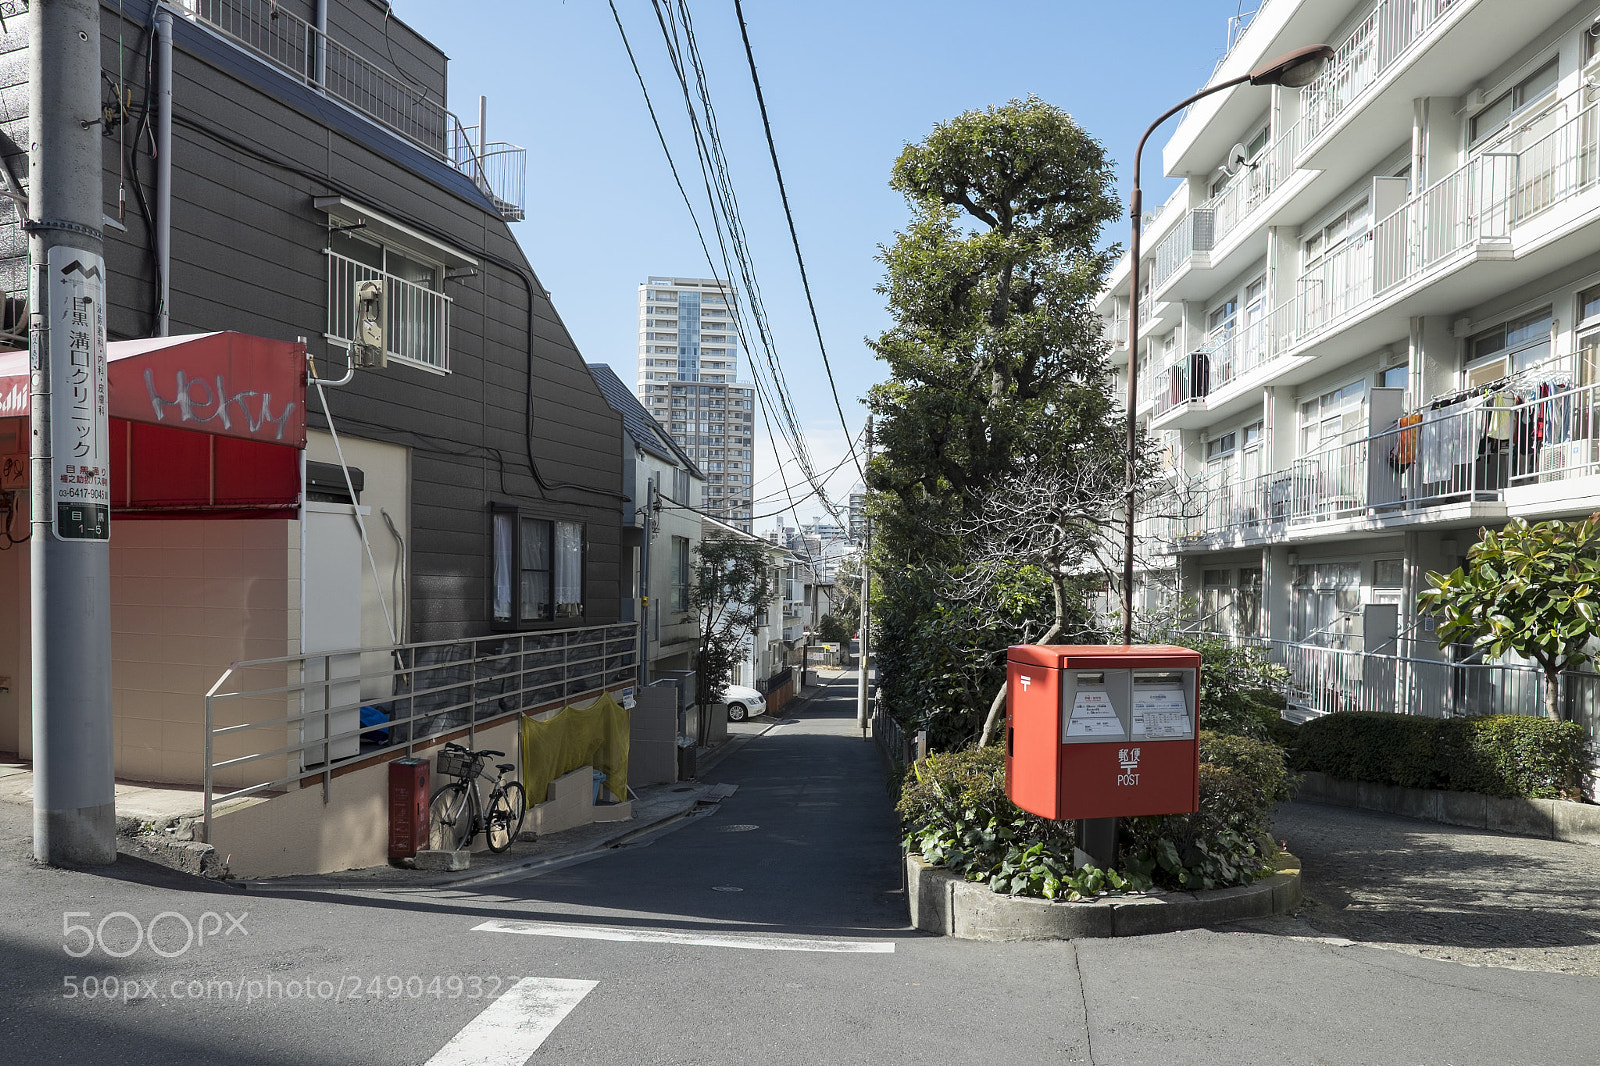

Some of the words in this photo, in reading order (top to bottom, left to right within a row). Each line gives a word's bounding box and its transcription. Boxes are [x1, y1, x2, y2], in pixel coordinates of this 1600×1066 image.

[69, 296, 90, 458] 目黒溝口クリニック
[0, 384, 28, 412] ahi
[1118, 747, 1141, 763] 郵便
[1117, 773, 1140, 786] POST
